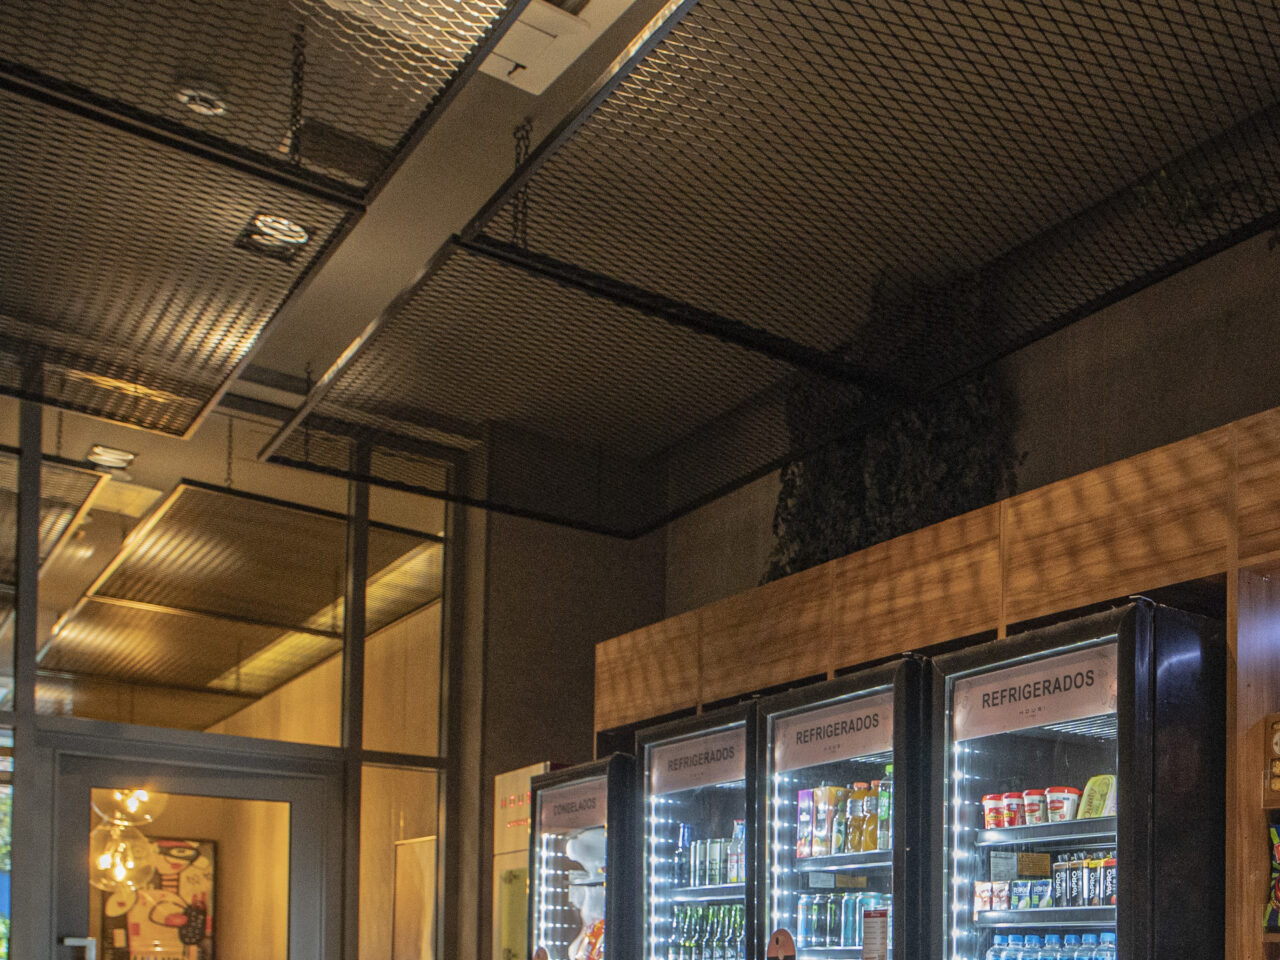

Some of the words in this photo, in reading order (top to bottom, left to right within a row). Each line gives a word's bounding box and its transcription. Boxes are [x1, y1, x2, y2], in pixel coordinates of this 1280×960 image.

[982, 669, 1095, 709] REFRIGERADOS
[796, 713, 879, 745] REFRIGERADOS
[667, 746, 735, 772] REFRIGERADOS
[553, 797, 597, 816] CONGELADOS
